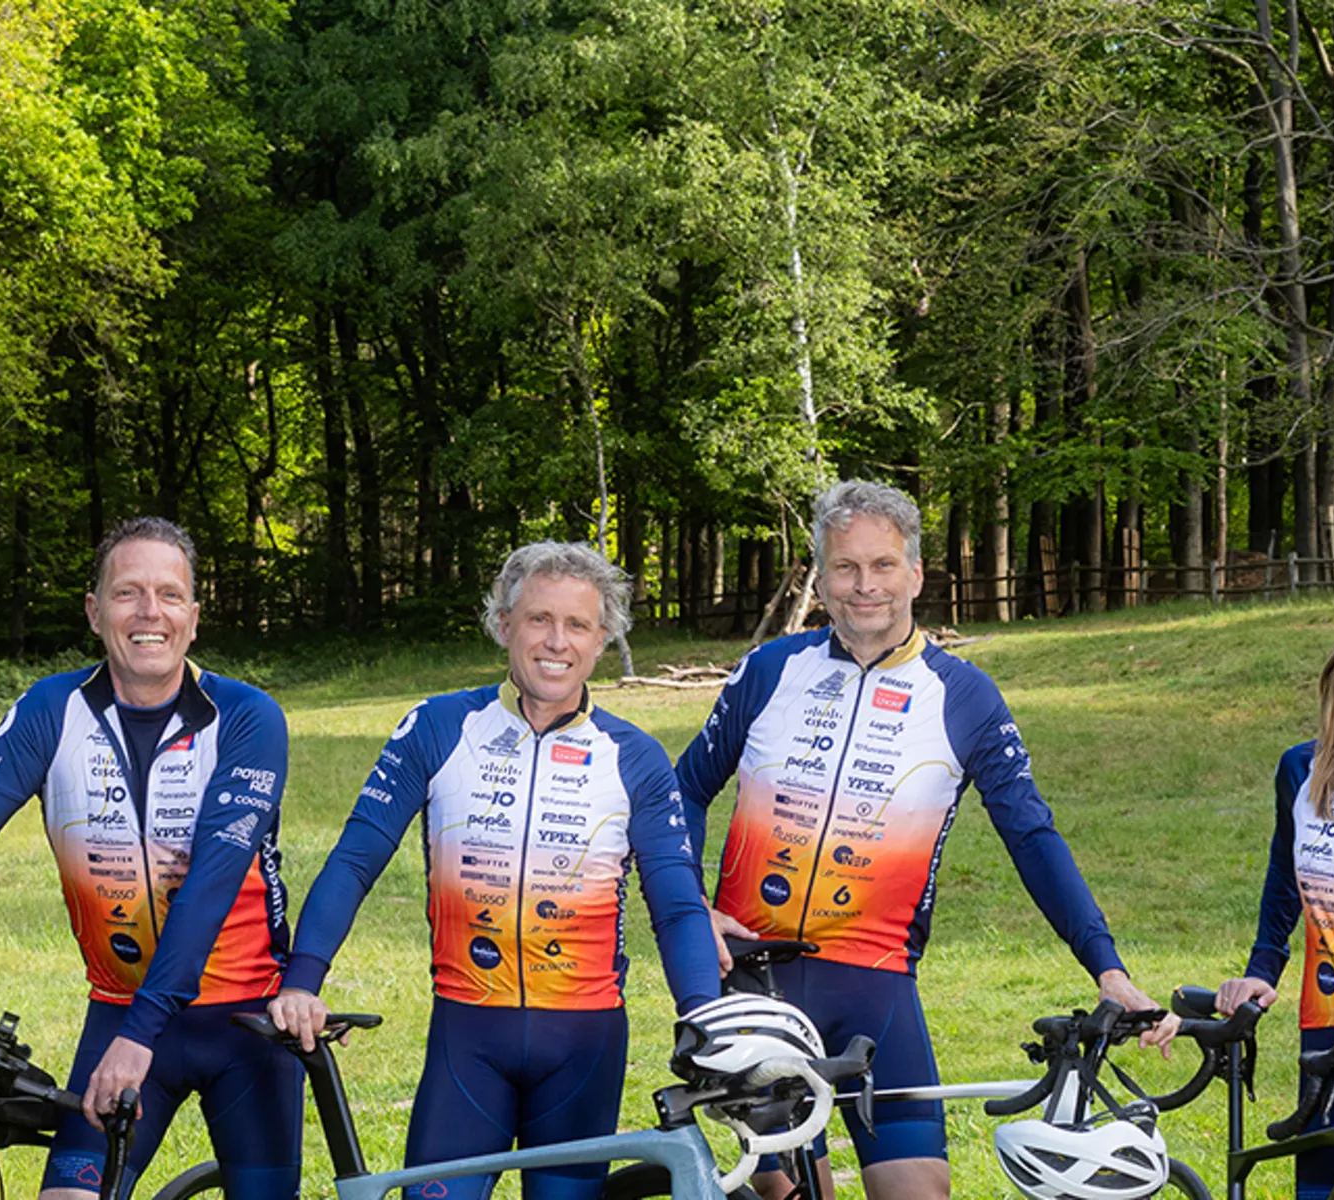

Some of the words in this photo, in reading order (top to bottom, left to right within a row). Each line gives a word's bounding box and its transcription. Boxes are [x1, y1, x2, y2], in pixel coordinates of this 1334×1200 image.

[811, 734, 834, 752] 10
[105, 786, 126, 803] 10
[848, 776, 896, 796] YPEX.nl
[492, 790, 515, 808] 10
[537, 830, 591, 847] YPEX.nl
[832, 884, 852, 906] 6
